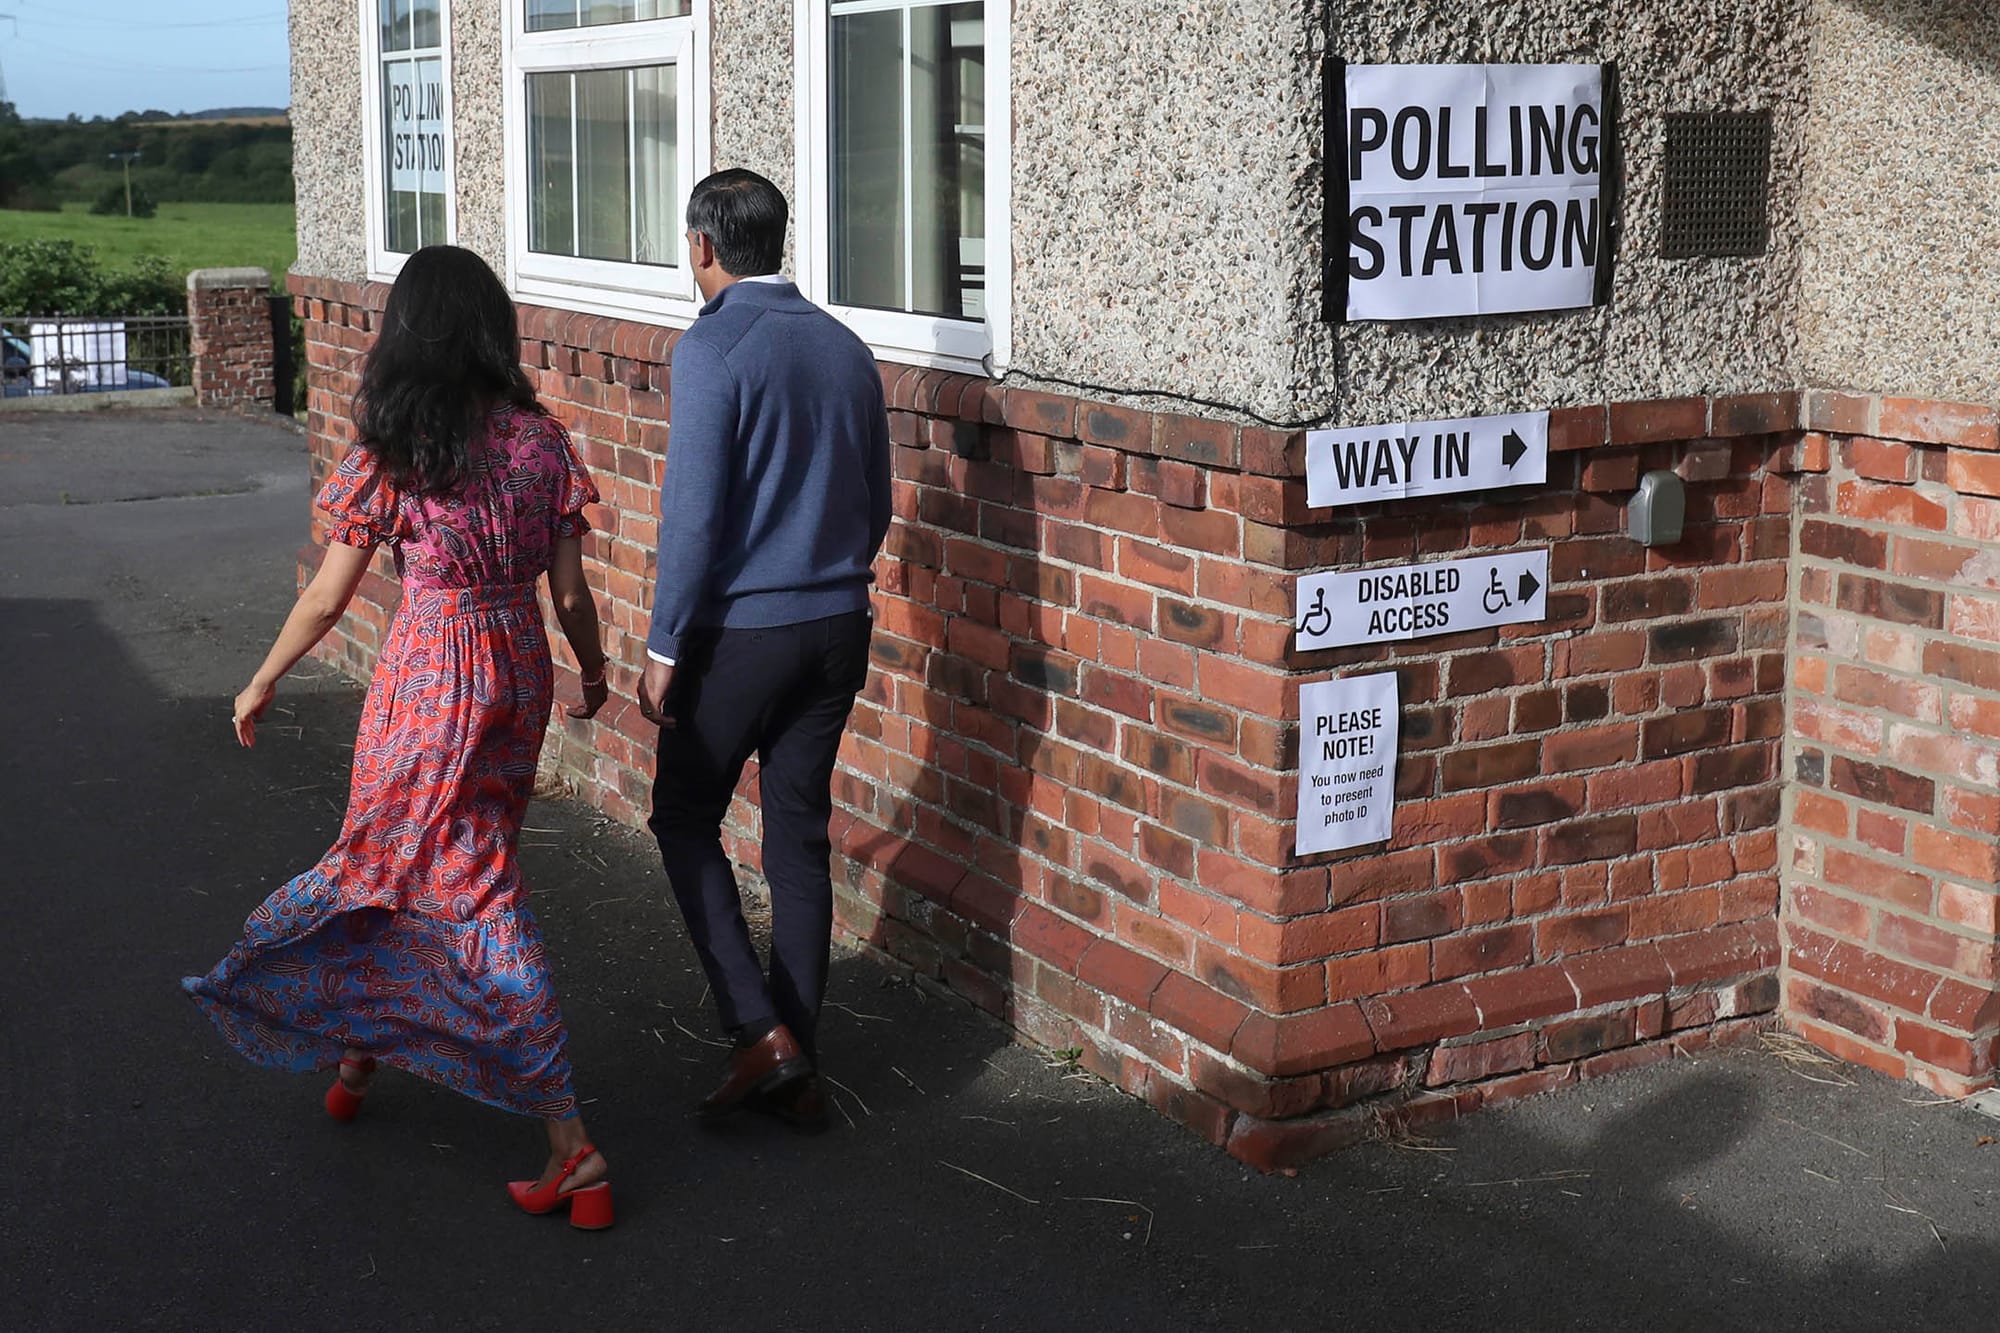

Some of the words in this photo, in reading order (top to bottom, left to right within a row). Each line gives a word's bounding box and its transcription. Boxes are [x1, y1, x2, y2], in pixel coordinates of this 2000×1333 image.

[393, 83, 444, 121] POLIN
[1350, 104, 1599, 181] POLLING
[1349, 198, 1597, 280] STATION
[1332, 436, 1420, 490] WAY
[1433, 431, 1470, 480] IN
[1358, 568, 1460, 603] DISABLED
[1367, 602, 1449, 635] ACCESS
[1316, 708, 1382, 736] PLEASE
[1323, 735, 1374, 761] NOTE!
[1311, 774, 1330, 788] You
[1334, 771, 1357, 785] now
[1359, 765, 1384, 780] need
[1321, 793, 1332, 806] to
[1335, 786, 1373, 806] present
[1324, 809, 1354, 827] photo
[1357, 805, 1367, 819] ID
